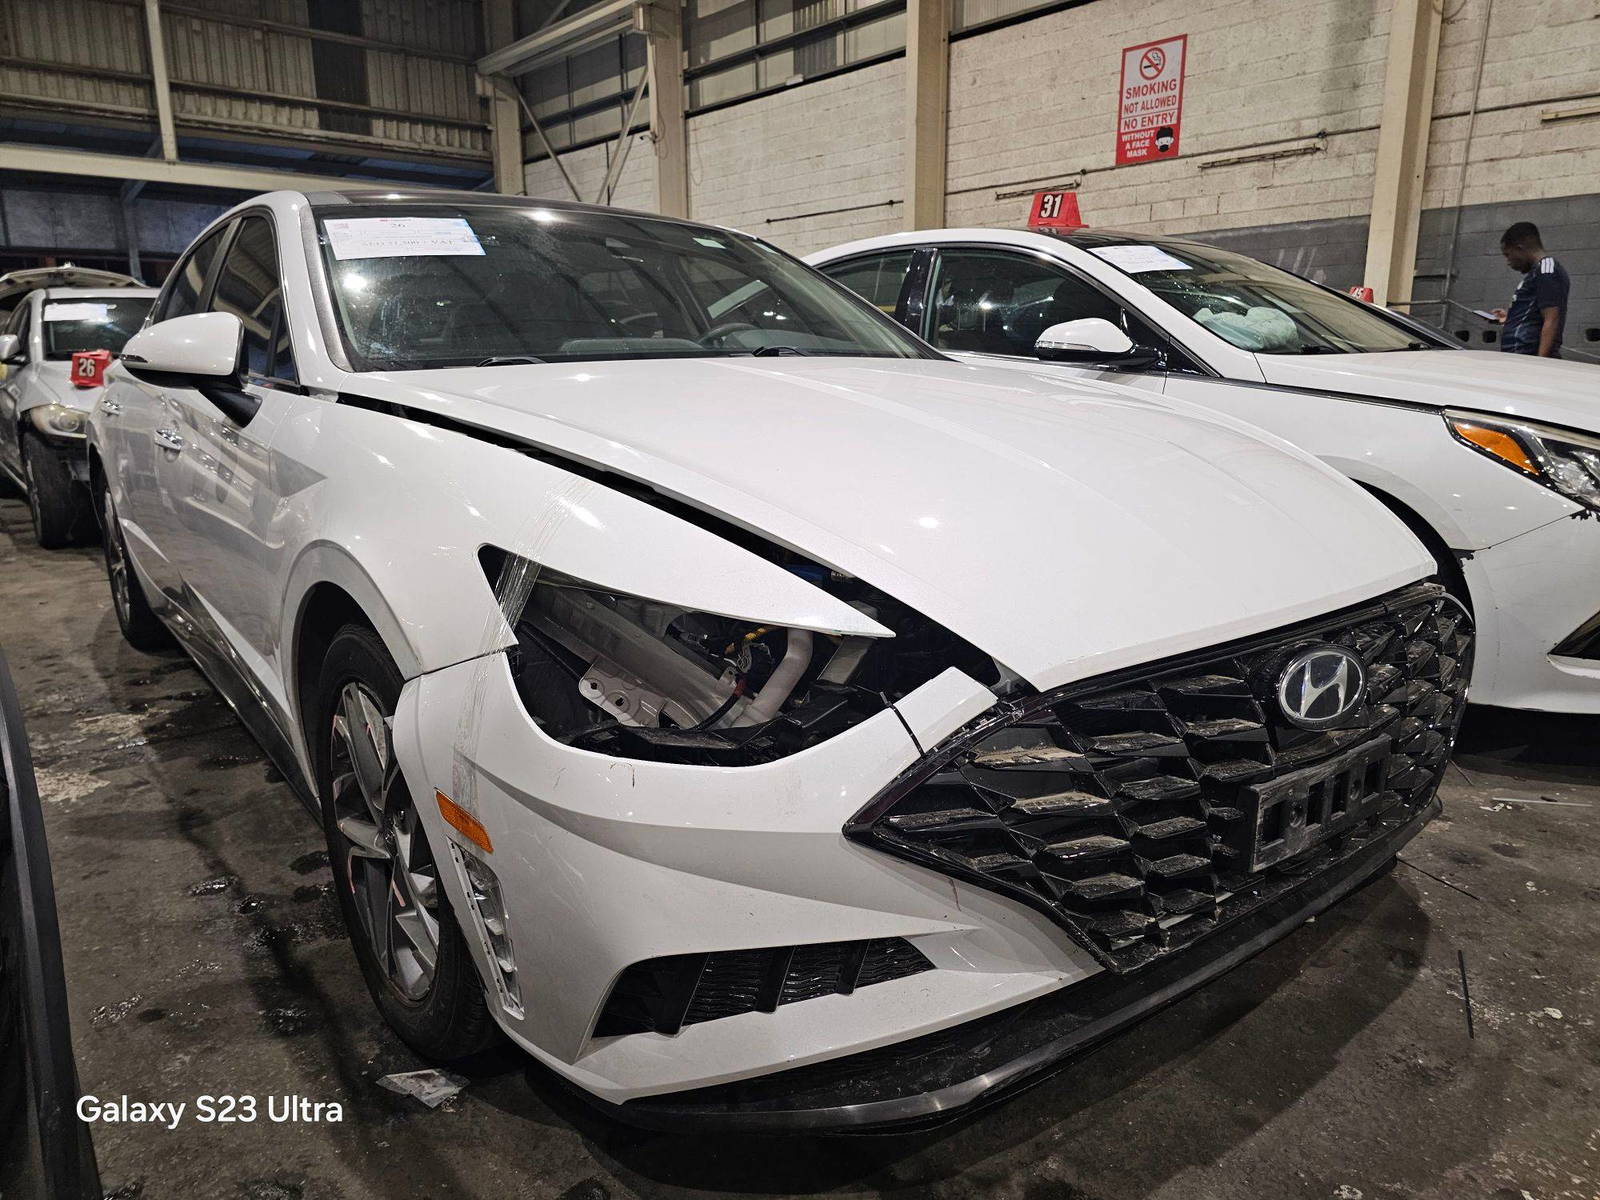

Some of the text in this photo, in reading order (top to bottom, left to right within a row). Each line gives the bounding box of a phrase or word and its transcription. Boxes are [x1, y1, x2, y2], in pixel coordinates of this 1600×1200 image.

[1125, 79, 1177, 99] SMOKING
[1124, 95, 1177, 115] NOT ALLOWED
[1124, 111, 1175, 131] NO ENTRY
[1122, 130, 1155, 142] WITHOUT
[1125, 139, 1150, 150] A FACE
[1126, 148, 1148, 158] MASK
[1040, 193, 1063, 218] 31
[79, 357, 96, 377] 26
